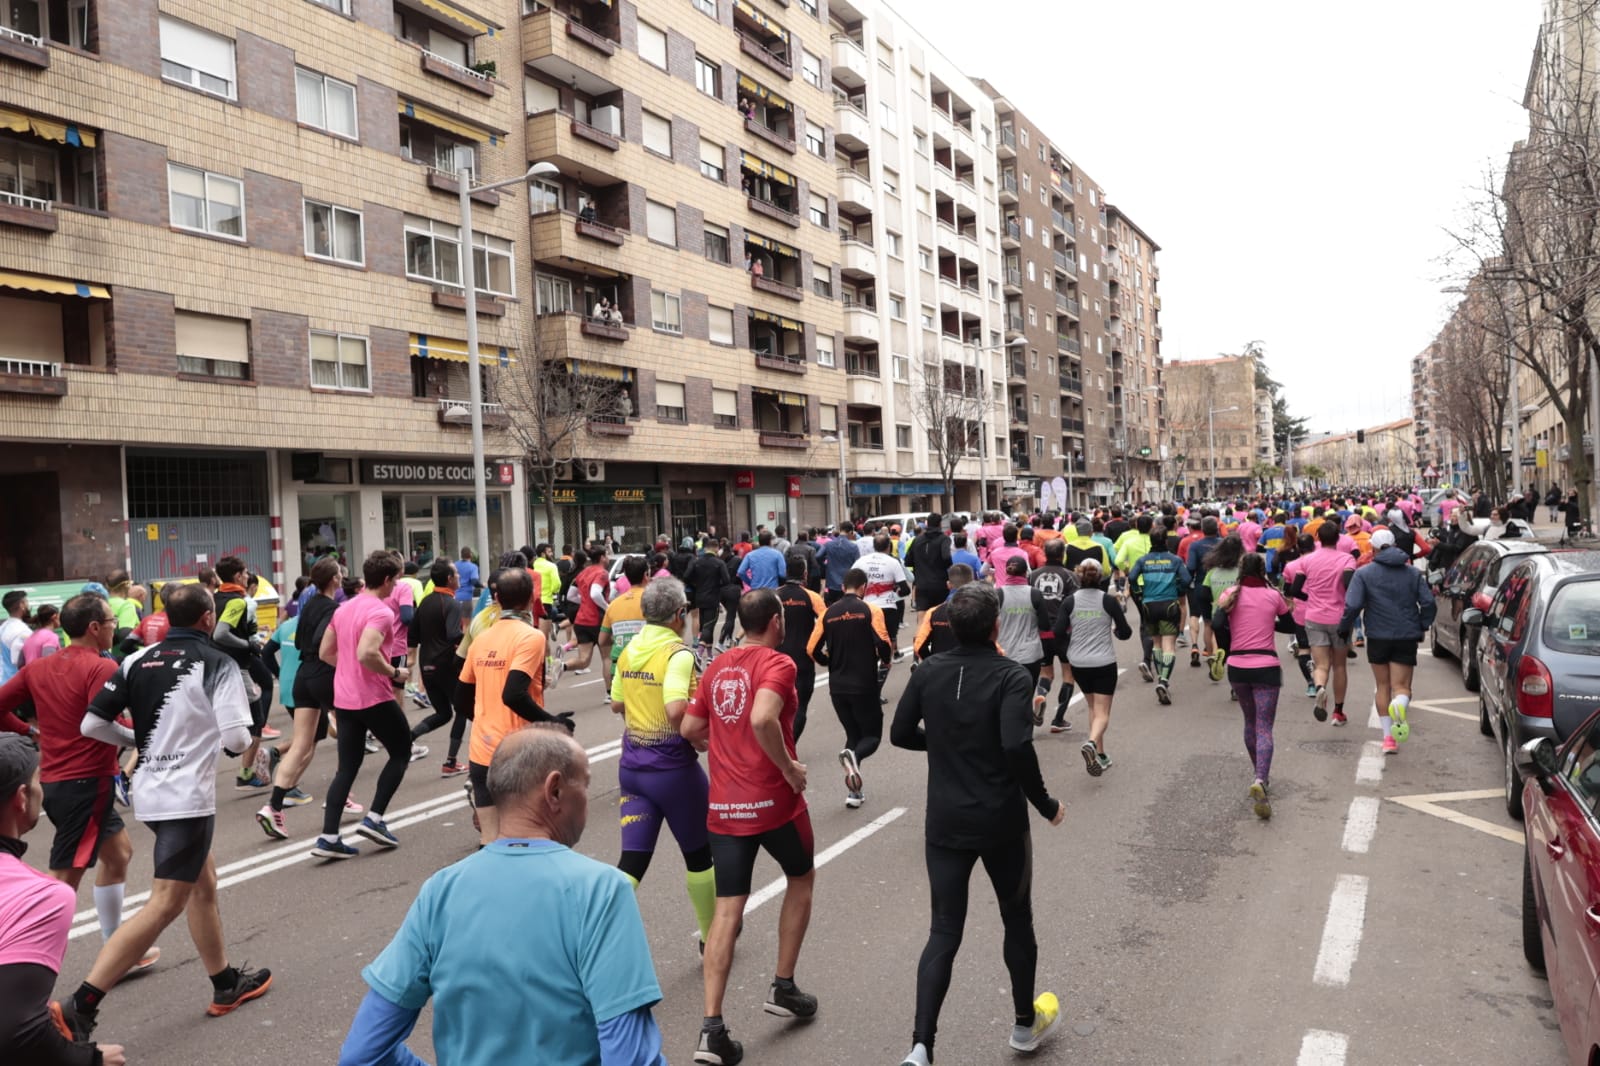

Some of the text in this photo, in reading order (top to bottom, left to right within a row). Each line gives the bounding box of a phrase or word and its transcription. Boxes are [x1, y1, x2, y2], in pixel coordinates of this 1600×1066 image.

[373, 464, 425, 480] ESTUDIO
[428, 466, 444, 480] DE
[446, 466, 492, 480] COCIS
[730, 800, 774, 810] POPULARES
[729, 810, 758, 819] MÉRIDA
